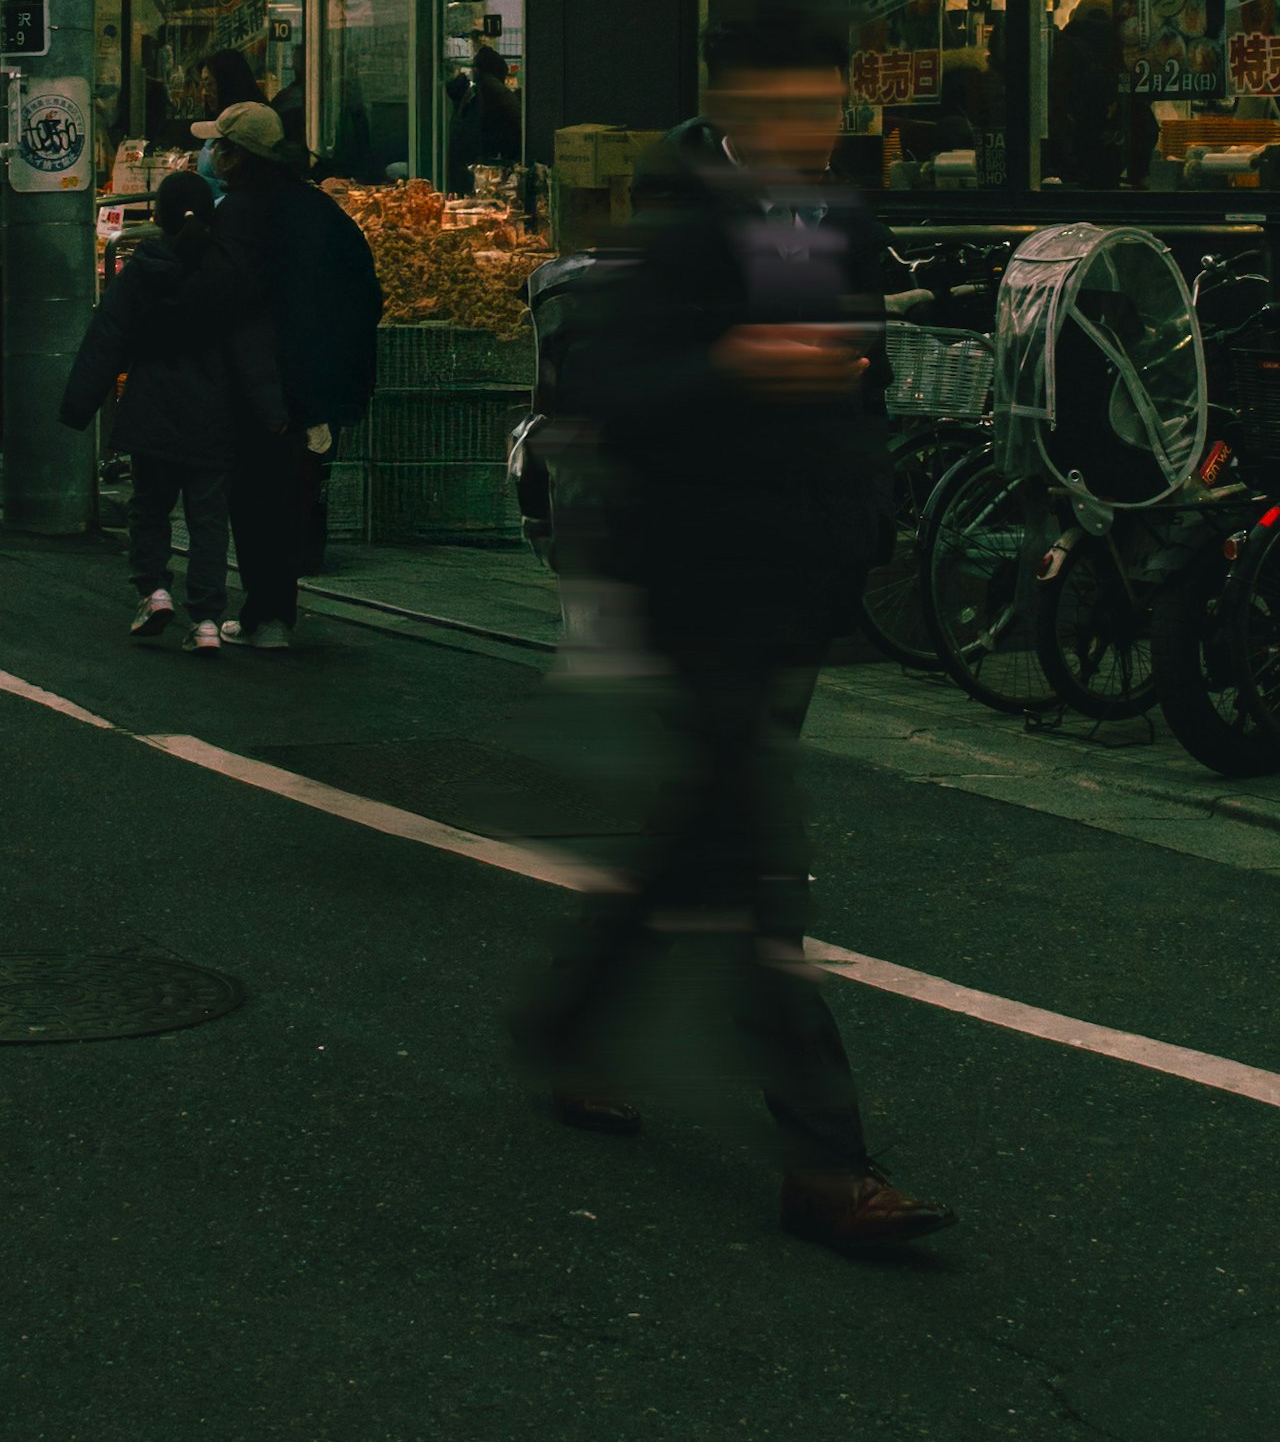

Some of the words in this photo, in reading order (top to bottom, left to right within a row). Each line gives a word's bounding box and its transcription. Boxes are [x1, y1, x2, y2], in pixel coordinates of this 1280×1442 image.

[274, 22, 289, 39] 10
[851, 50, 939, 103] 特売日
